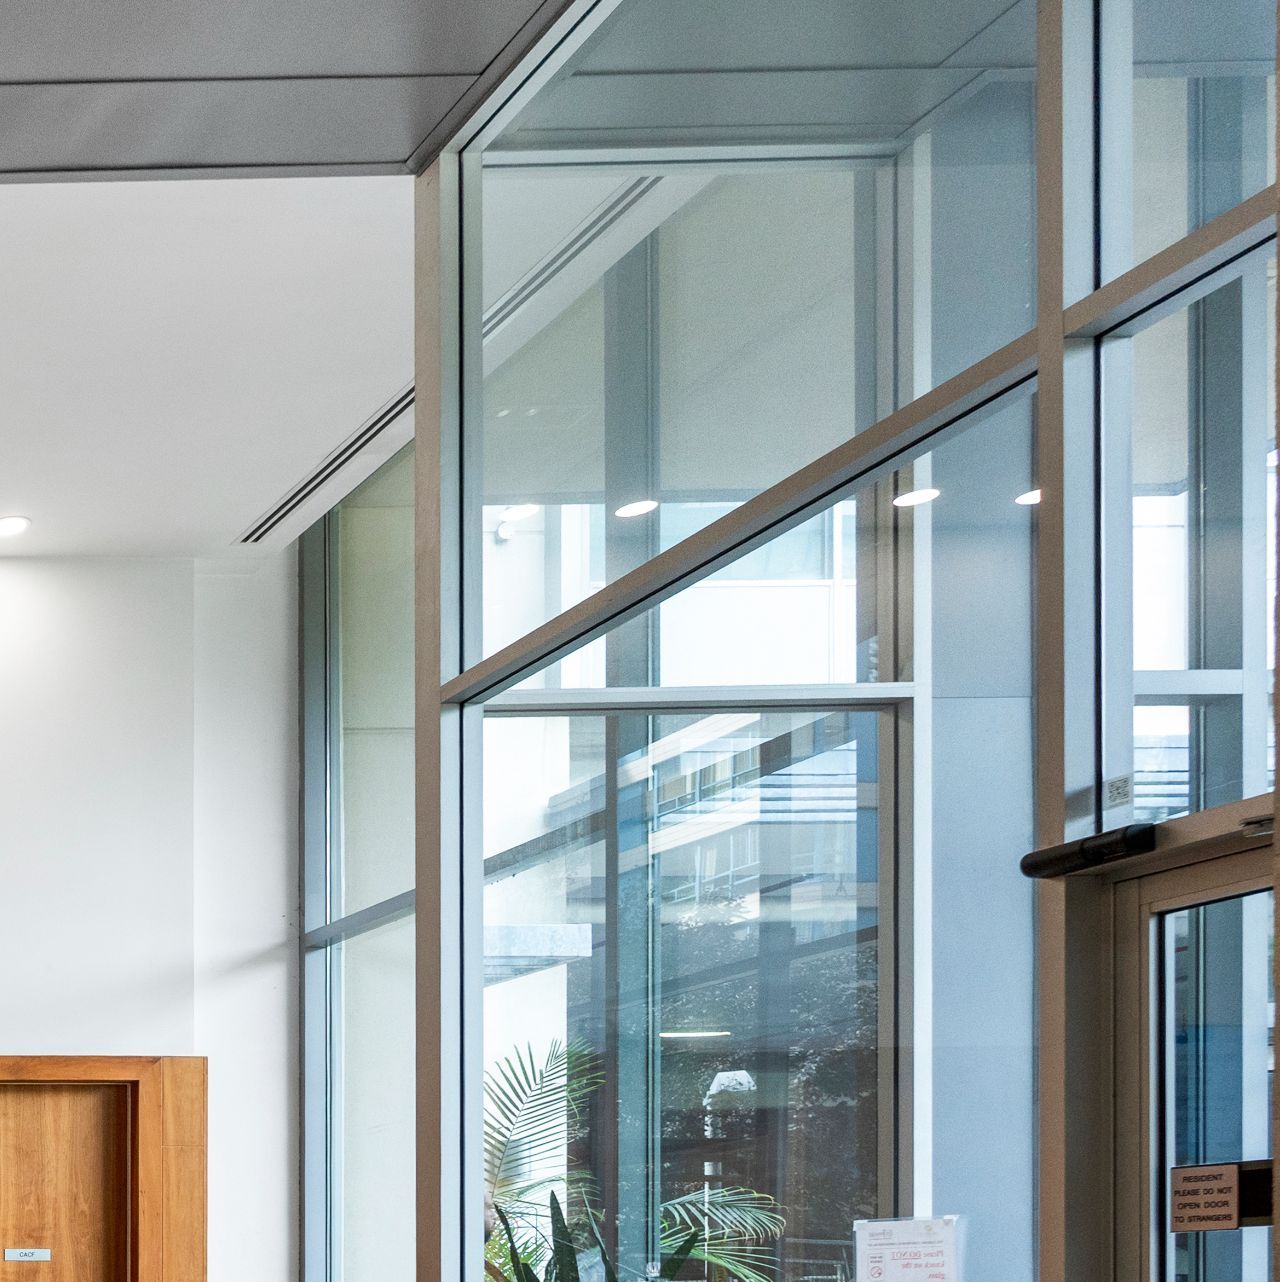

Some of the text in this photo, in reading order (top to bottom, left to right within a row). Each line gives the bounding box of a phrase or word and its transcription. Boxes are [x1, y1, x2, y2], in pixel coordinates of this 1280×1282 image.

[1182, 1174, 1224, 1183] RESIDENT
[1174, 1188, 1201, 1196] PLEASE
[1217, 1186, 1233, 1194] NOT
[1177, 1202, 1200, 1210] OPEN
[1187, 1214, 1233, 1223] STRANGERS
